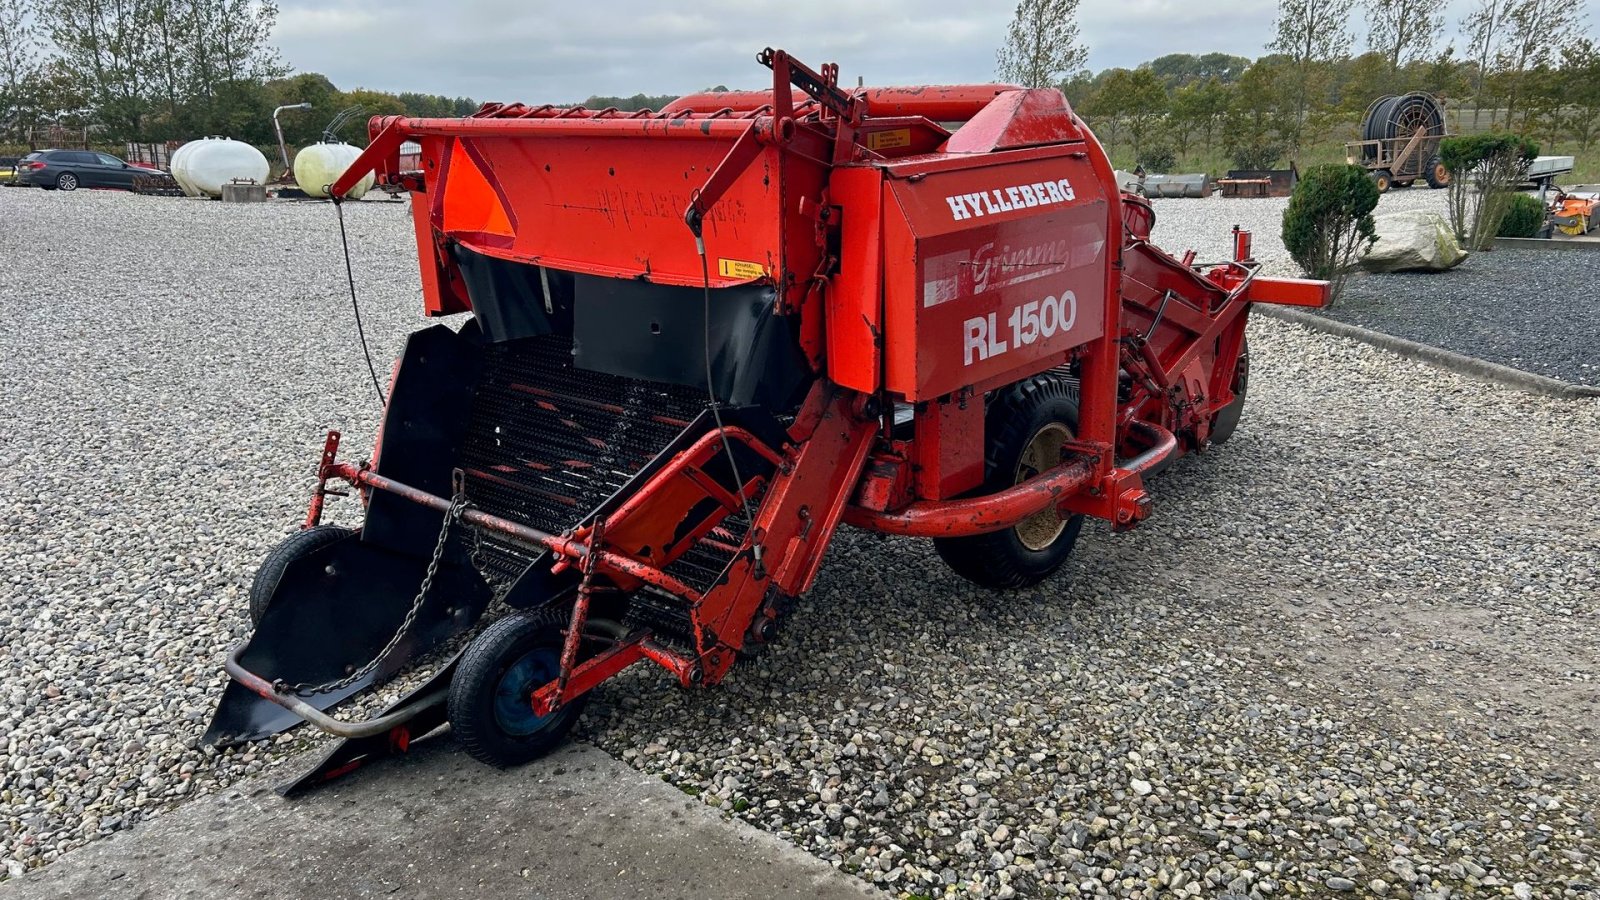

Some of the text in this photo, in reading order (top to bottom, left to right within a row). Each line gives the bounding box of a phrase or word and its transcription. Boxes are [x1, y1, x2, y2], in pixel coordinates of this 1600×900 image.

[945, 178, 1076, 221] HYLLEBERG
[971, 239, 1070, 295] Grimme
[963, 289, 1077, 367] RL 1500
